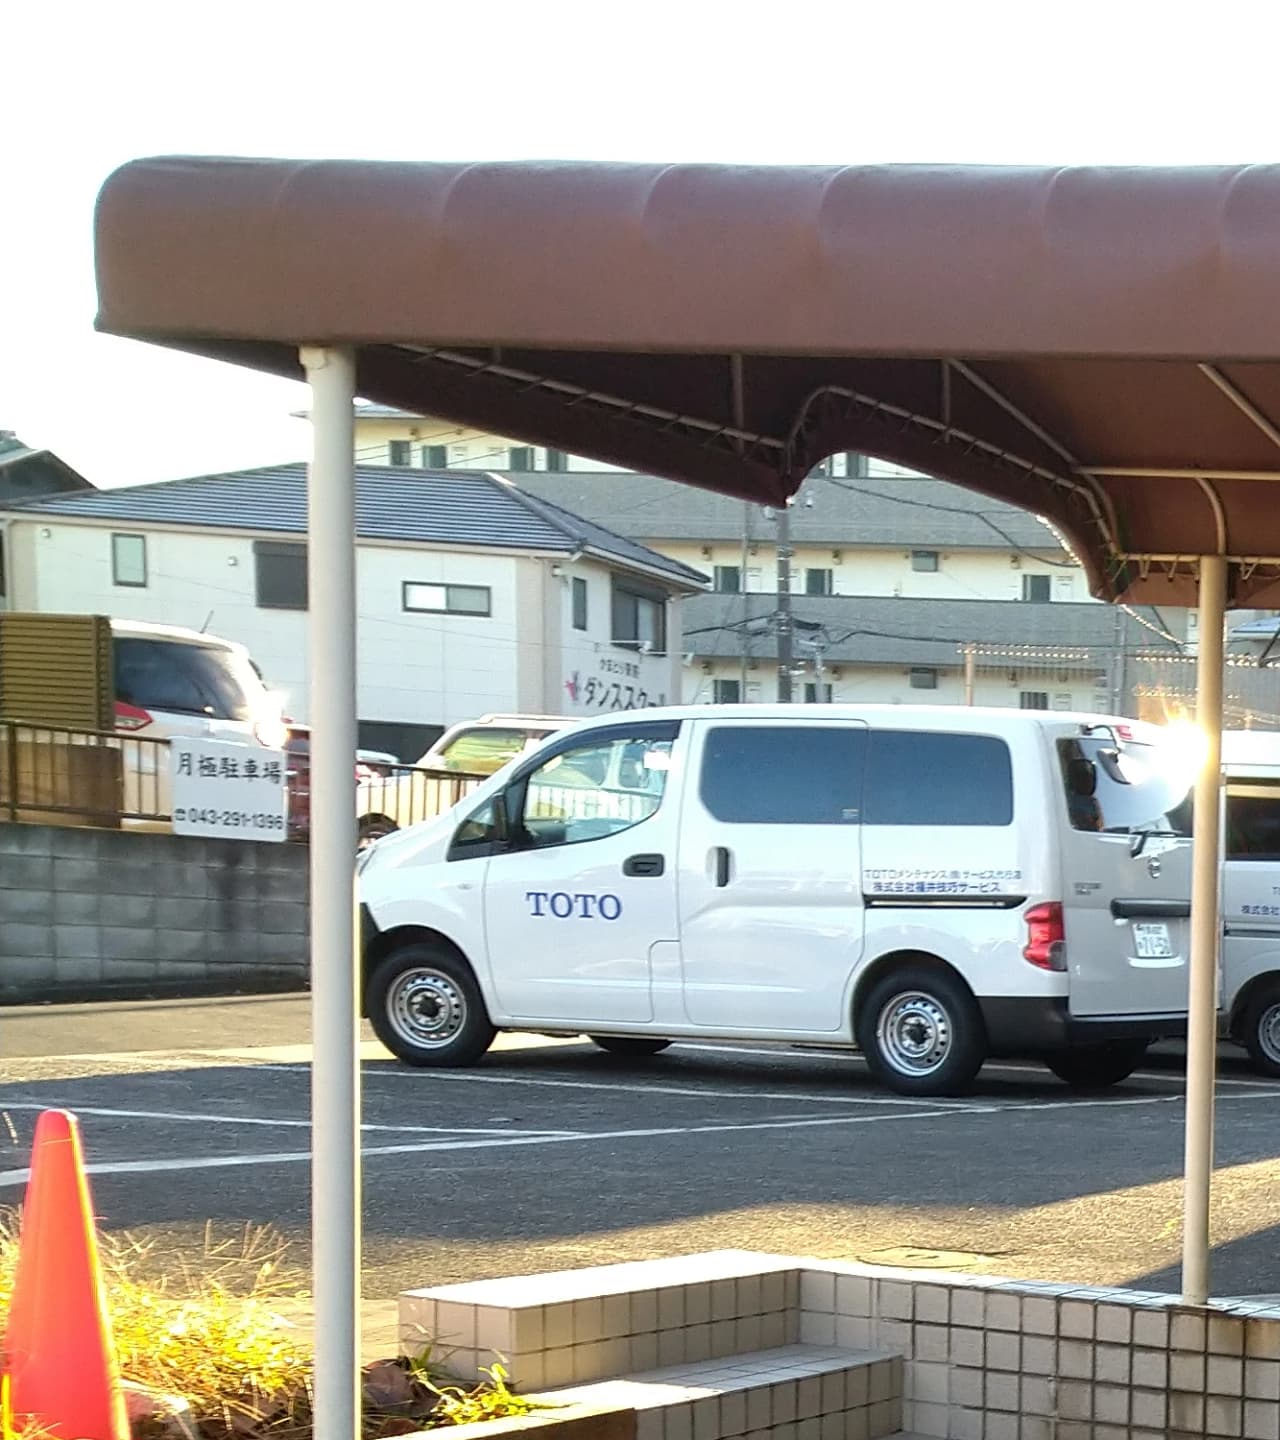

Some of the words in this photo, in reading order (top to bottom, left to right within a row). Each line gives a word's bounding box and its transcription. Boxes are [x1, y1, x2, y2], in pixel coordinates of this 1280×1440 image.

[175, 751, 282, 784] 月極駐車場
[189, 807, 284, 831] 043-291-1396
[525, 891, 623, 921] TOTO
